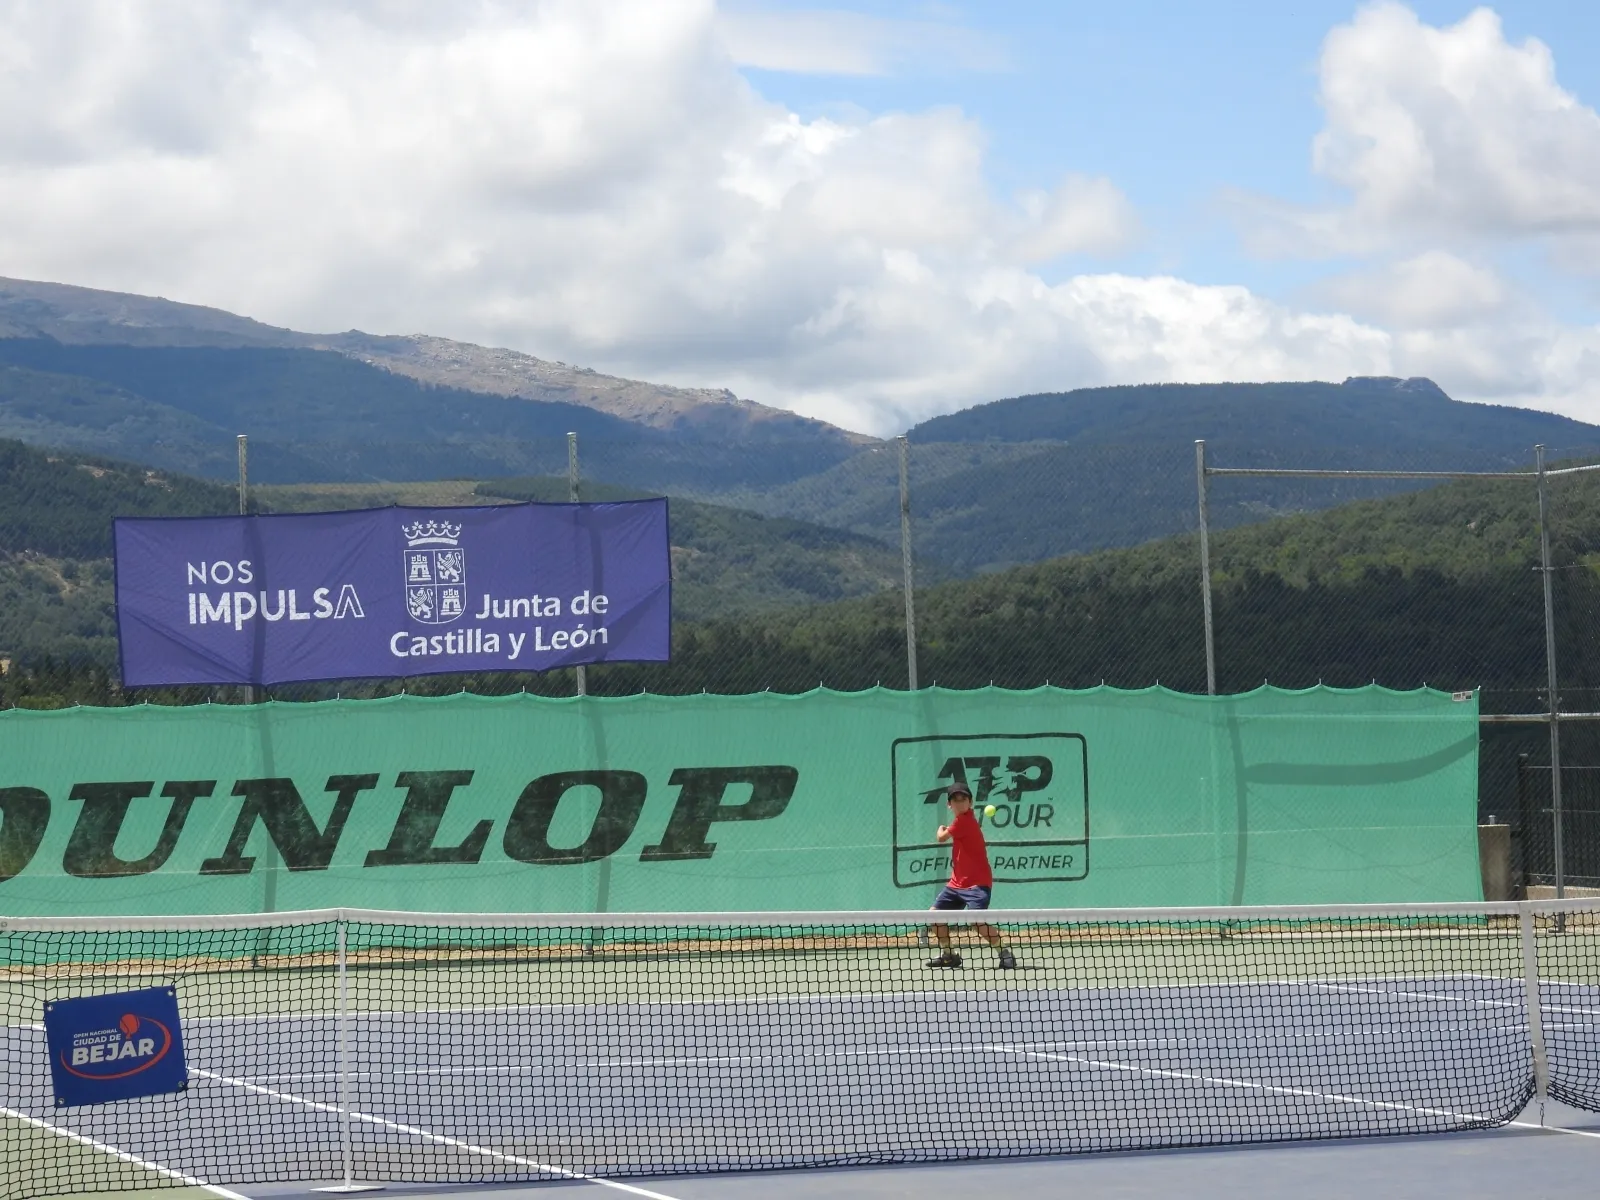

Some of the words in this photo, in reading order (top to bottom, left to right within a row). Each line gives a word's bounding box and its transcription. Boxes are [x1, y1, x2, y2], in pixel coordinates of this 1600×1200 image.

[187, 560, 253, 585] NOS
[188, 584, 365, 631] IMPULSA
[475, 593, 561, 620] Junta
[570, 590, 609, 616] de
[390, 628, 500, 657] Castilla
[507, 632, 526, 660] y
[535, 623, 608, 652] León
[918, 755, 1053, 804] ATP
[993, 854, 1074, 871] PARTNER
[73, 1035, 108, 1047] CIUDAD
[109, 1033, 122, 1042] DE
[89, 1028, 118, 1037] NACIONAL
[71, 1038, 155, 1066] BEJAR
